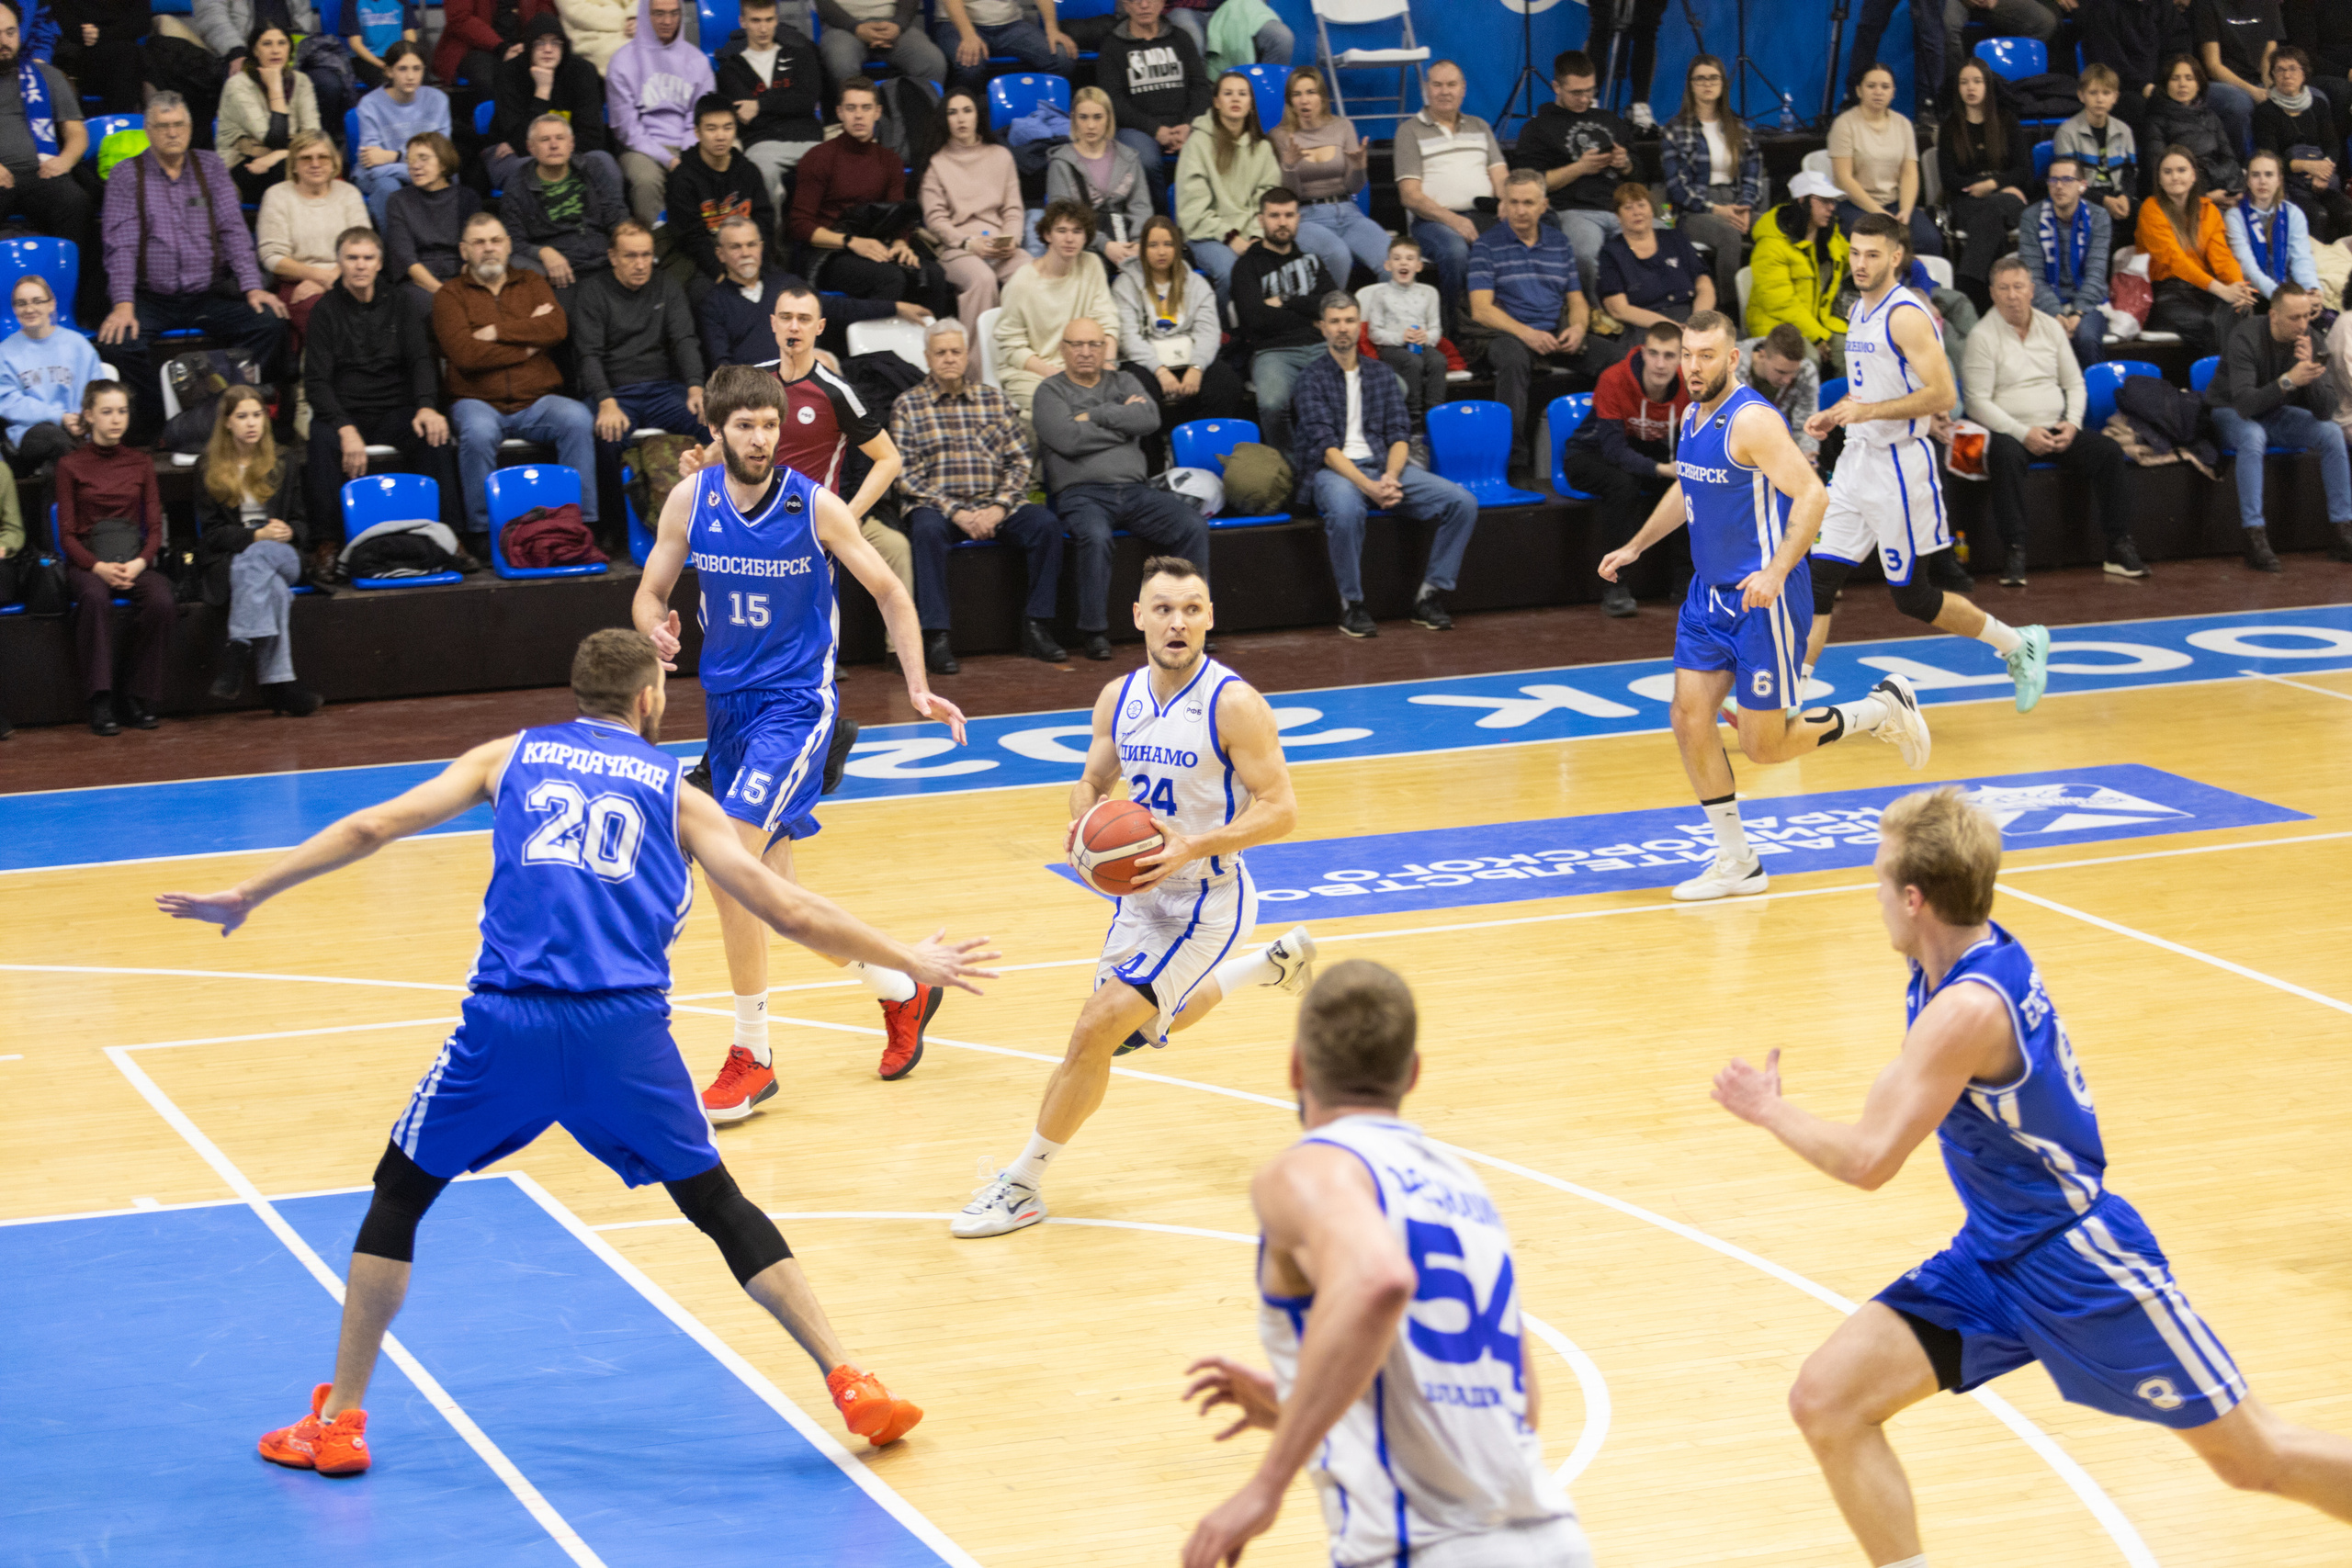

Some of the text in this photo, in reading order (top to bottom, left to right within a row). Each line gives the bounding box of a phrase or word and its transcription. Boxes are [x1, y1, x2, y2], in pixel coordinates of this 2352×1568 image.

[1854, 360, 1863, 387] 3
[1684, 492, 1695, 525] 6
[691, 551, 812, 578] НОВОСИБИРСК
[1883, 548, 1903, 571] 3
[729, 591, 772, 629] 15
[1751, 668, 1774, 698] 6
[1186, 706, 1203, 716] РФБ
[521, 741, 671, 795] КИРДЯЧКИН
[1121, 744, 1199, 769] ДИНАМО
[726, 765, 774, 807] 15
[1131, 773, 1178, 817] 24
[521, 778, 647, 885] 20
[2052, 1012, 2095, 1114] 8
[1404, 1217, 1526, 1394] 54
[2132, 1374, 2186, 1412] 8
